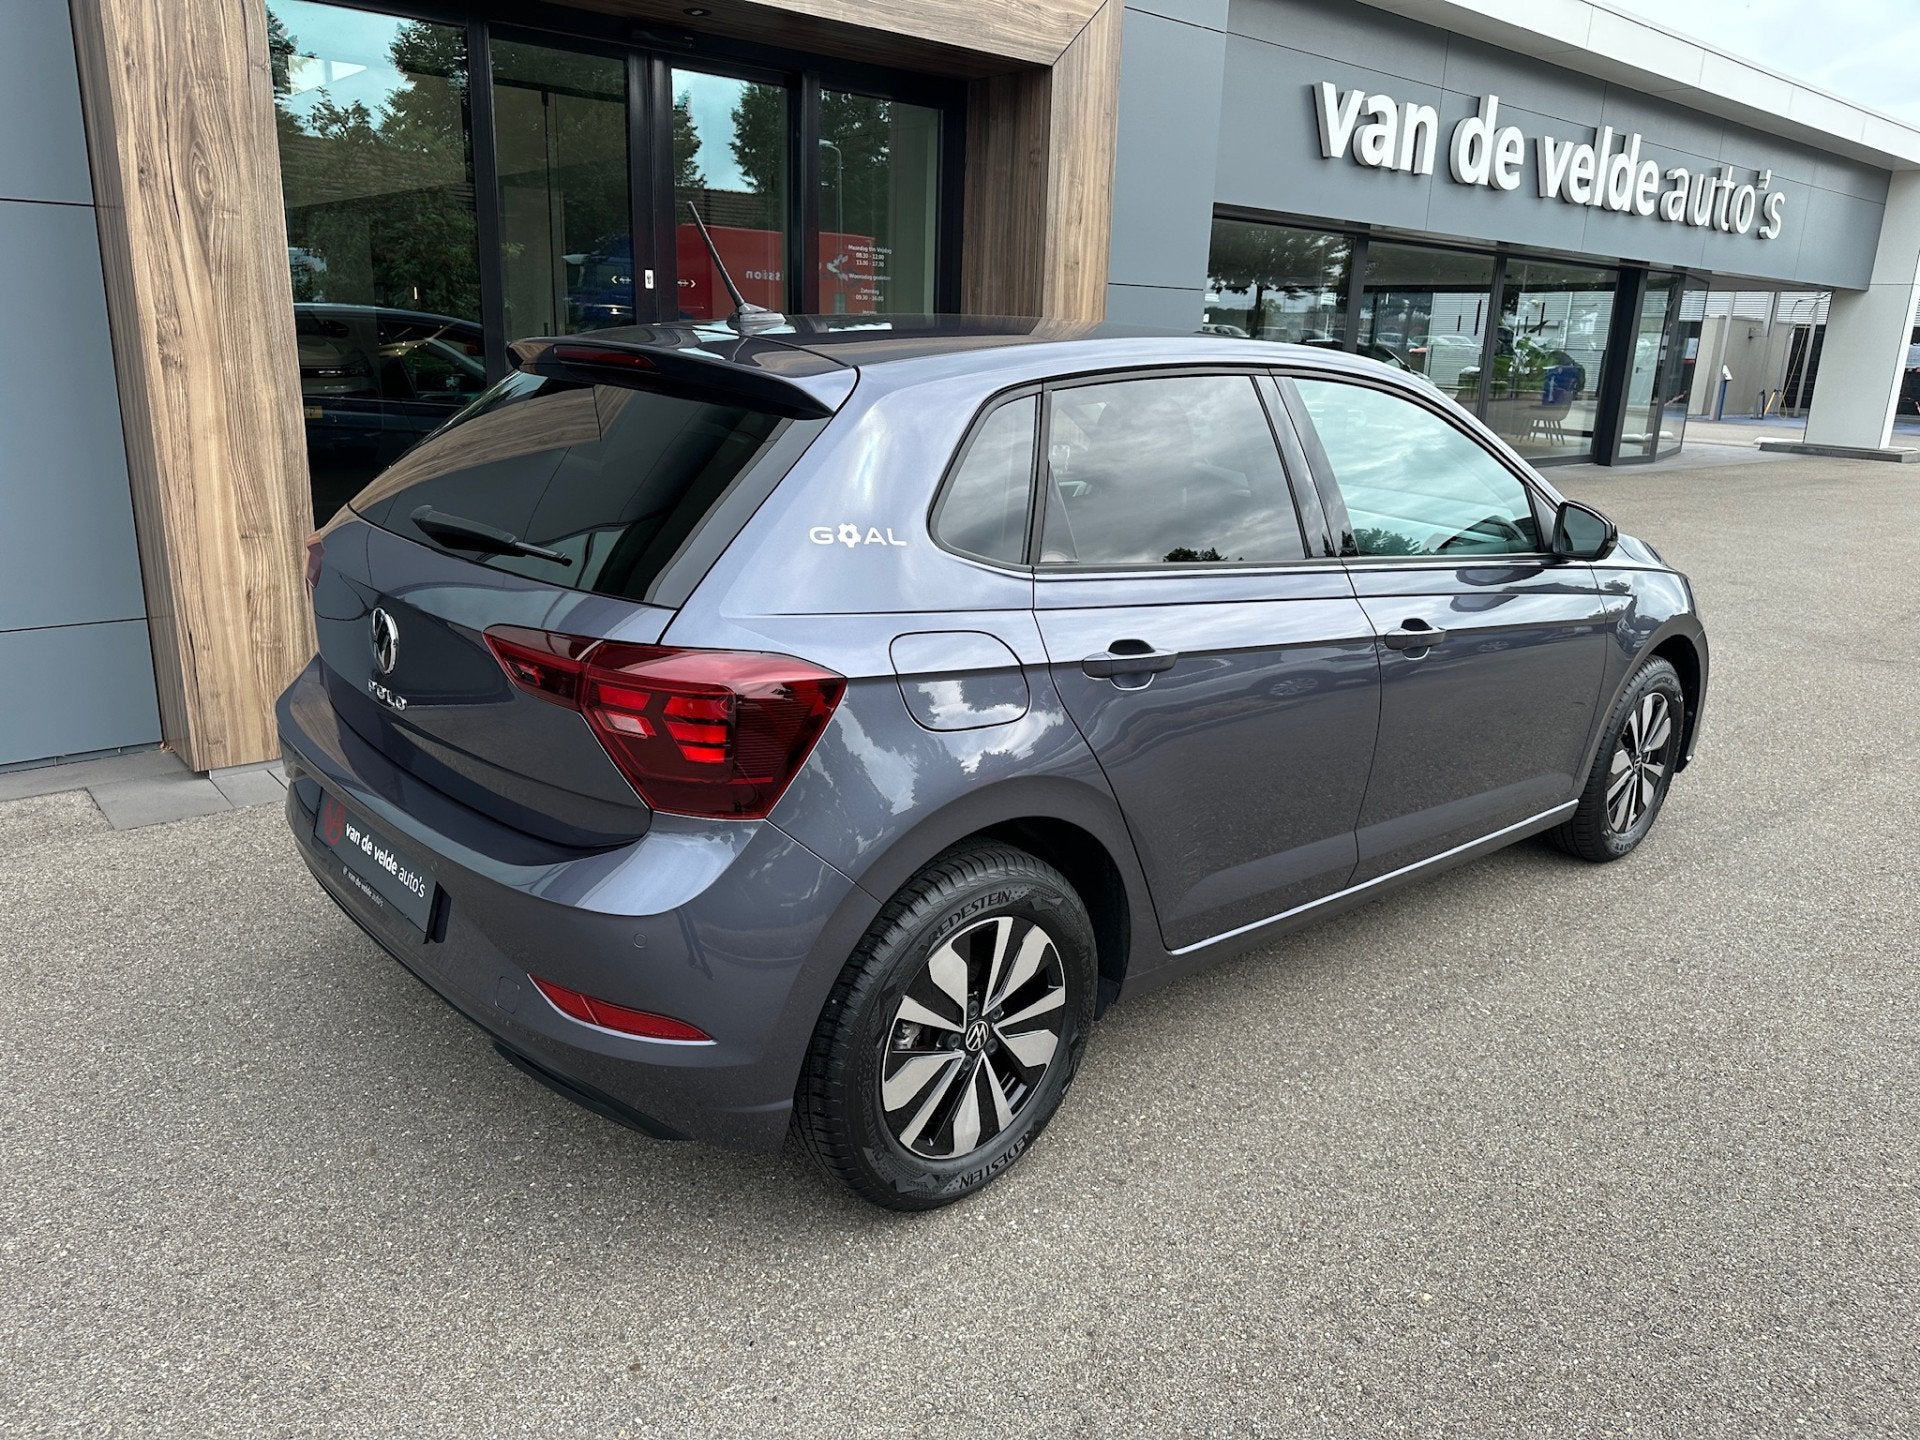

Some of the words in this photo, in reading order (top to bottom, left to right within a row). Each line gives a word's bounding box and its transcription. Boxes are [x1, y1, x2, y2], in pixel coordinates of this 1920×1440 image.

[1313, 81, 1438, 175] van
[1449, 94, 1525, 191] de
[1537, 125, 1660, 217] velde
[1660, 164, 1786, 239] auto's
[809, 523, 907, 549] GOAL
[368, 679, 408, 711] POLO
[346, 823, 361, 846] van
[361, 834, 373, 855] de
[374, 846, 398, 875] velde
[398, 867, 426, 898] auto's
[918, 890, 1012, 952] REDESTEIN
